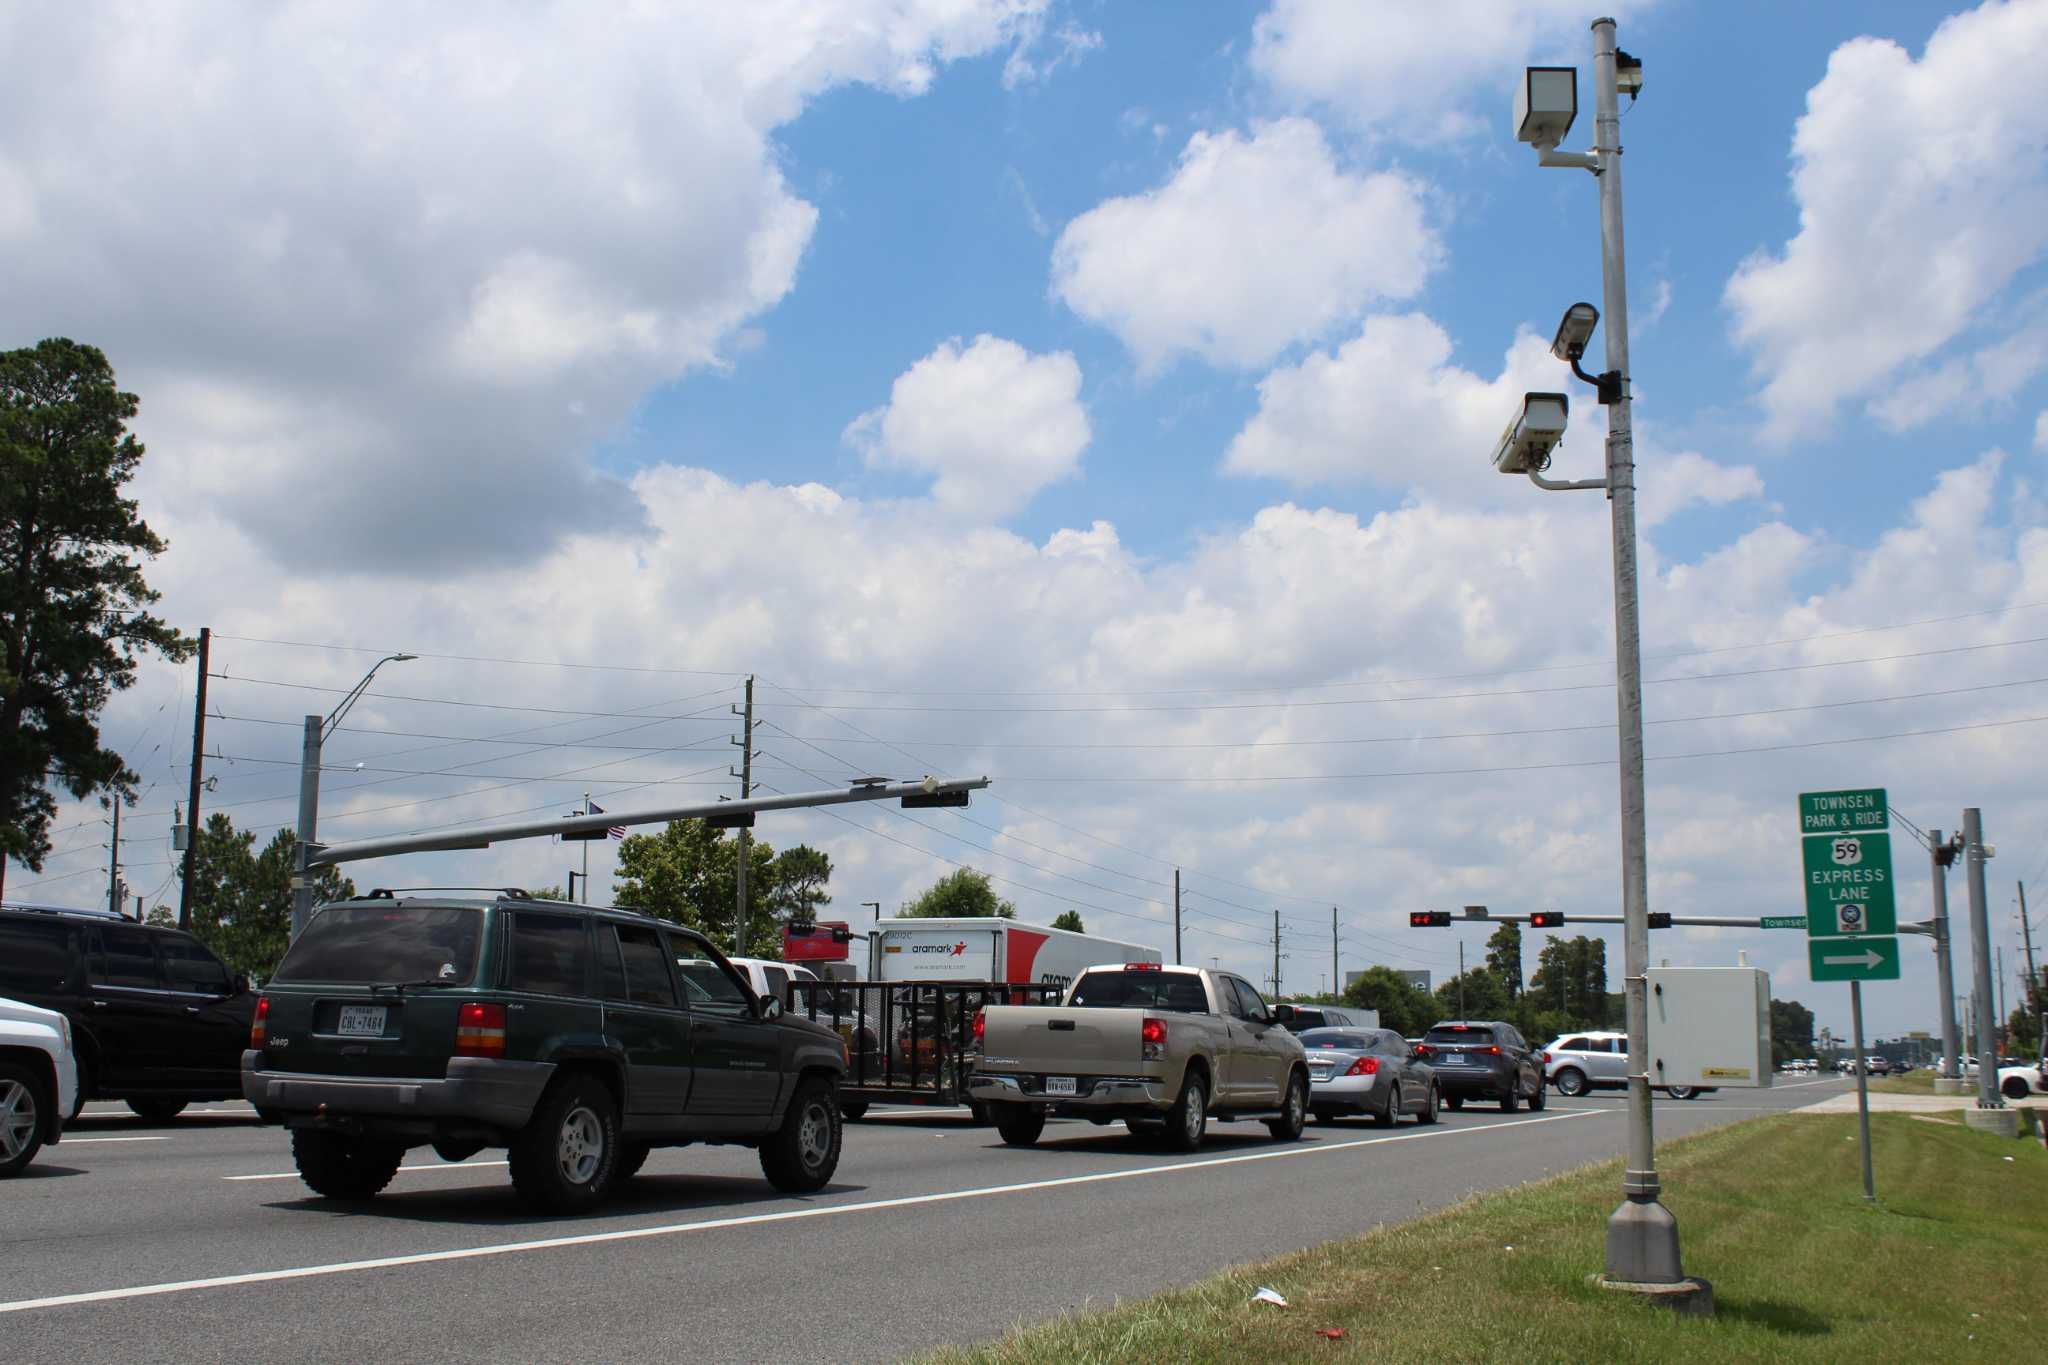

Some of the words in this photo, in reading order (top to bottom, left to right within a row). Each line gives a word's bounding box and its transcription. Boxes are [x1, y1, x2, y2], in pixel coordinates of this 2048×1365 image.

[1814, 795, 1874, 810] TOWNSEN
[1805, 814, 1836, 827] PARK
[1841, 813, 1850, 826] &
[1856, 811, 1884, 825] RIDE
[1835, 844, 1858, 860] 59
[1812, 869, 1885, 884] EXPRESS
[1829, 887, 1870, 900] LANE
[912, 944, 952, 953] aramark
[270, 1037, 289, 1047] Jeep
